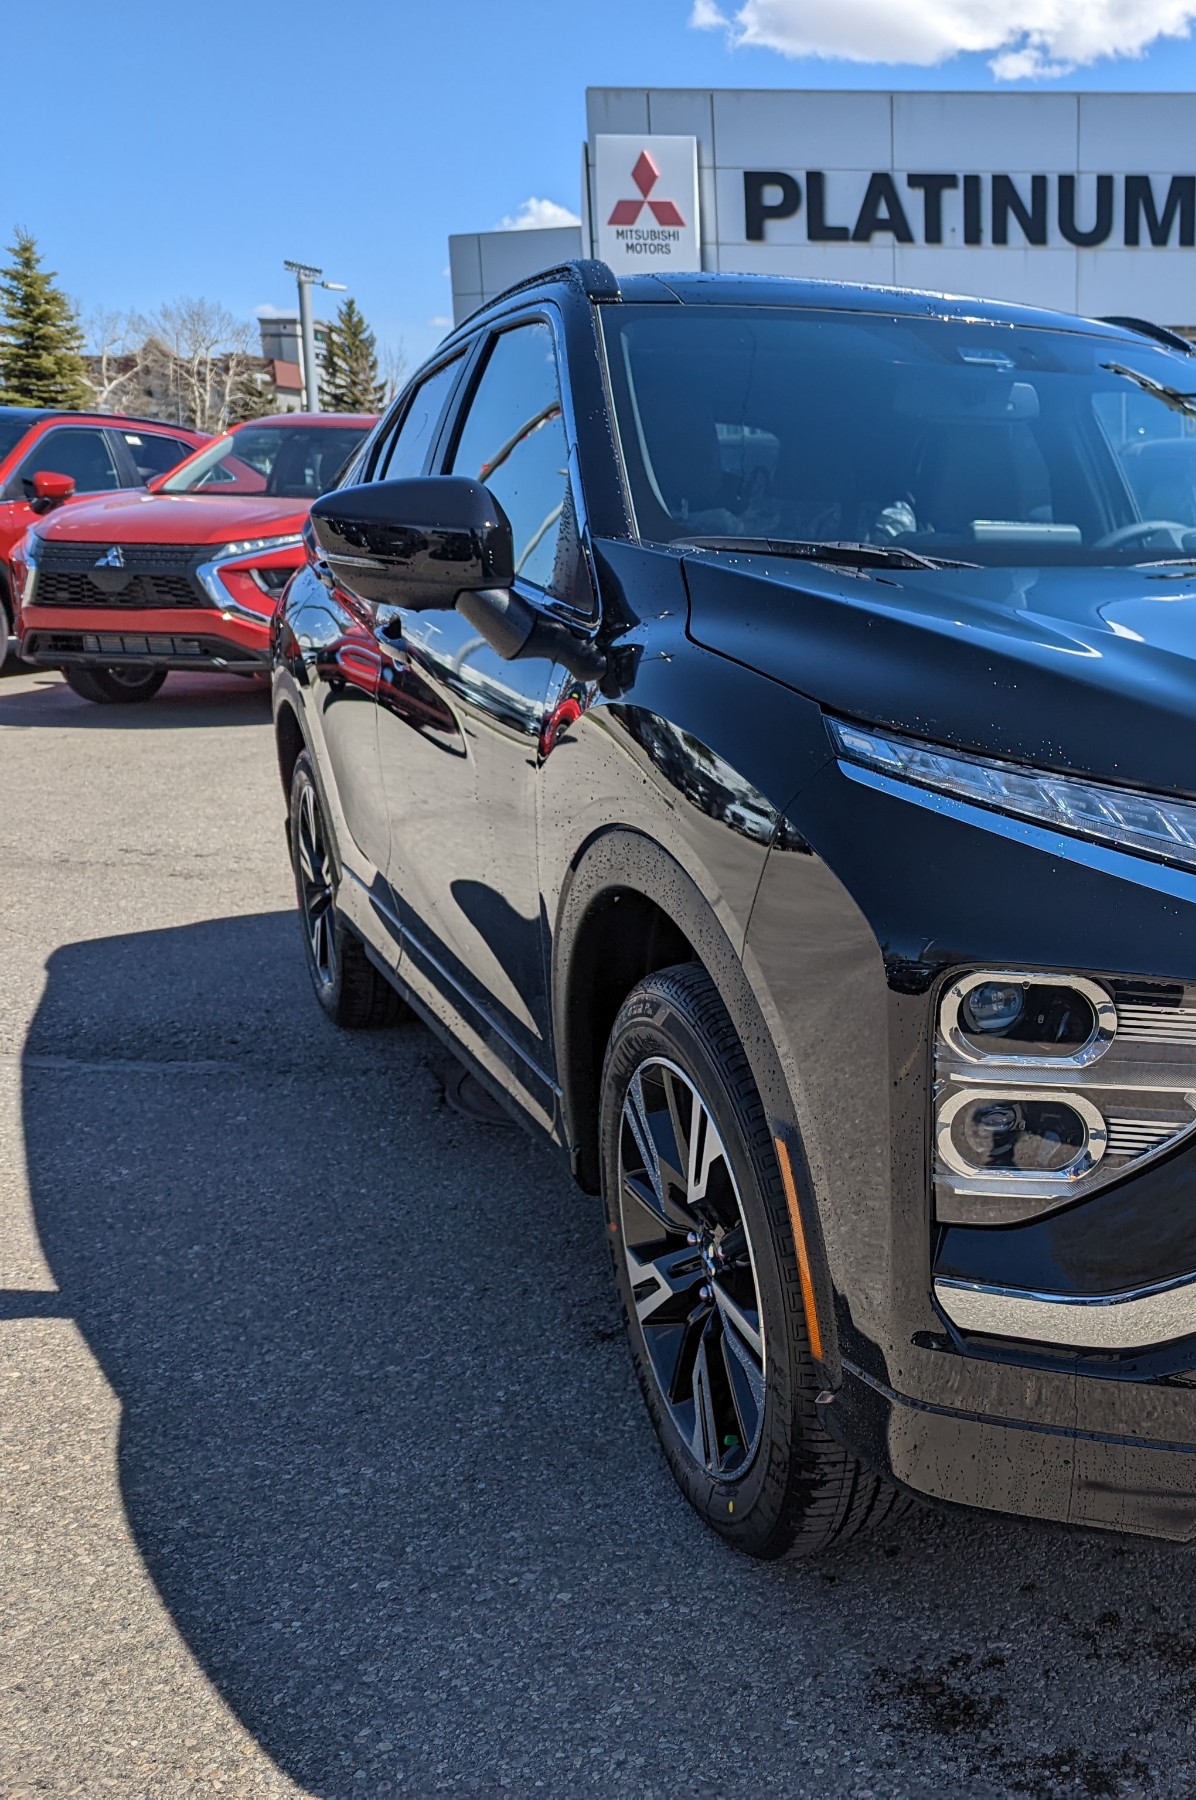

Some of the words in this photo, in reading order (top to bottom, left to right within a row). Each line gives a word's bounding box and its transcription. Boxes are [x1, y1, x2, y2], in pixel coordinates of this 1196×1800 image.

[743, 170, 1196, 248] PLATINUM
[616, 229, 680, 241] MITSUBISHI
[626, 243, 672, 254] MOTORS
